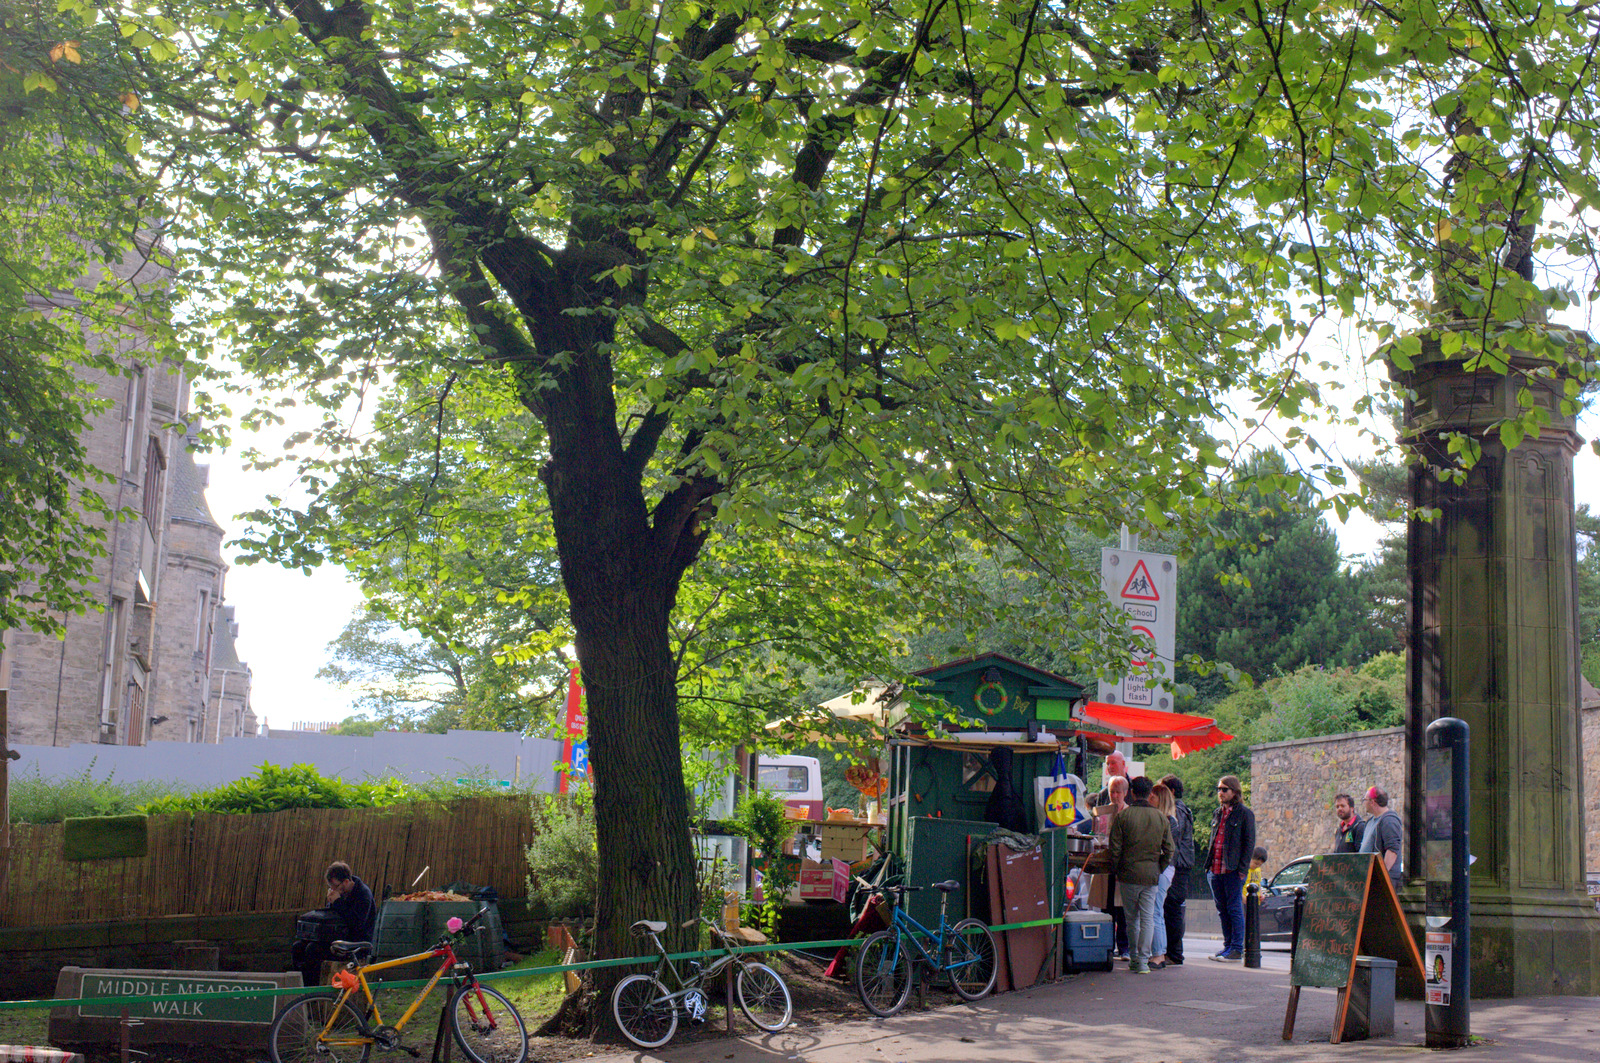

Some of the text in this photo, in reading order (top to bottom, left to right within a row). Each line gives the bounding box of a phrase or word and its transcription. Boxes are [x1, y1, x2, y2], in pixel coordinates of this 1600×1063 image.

[1128, 692, 1147, 701] flash
[575, 748, 584, 767] P
[1343, 880, 1364, 893] FOOD
[97, 979, 170, 996] MIDDLE
[152, 1000, 205, 1016] WALK
